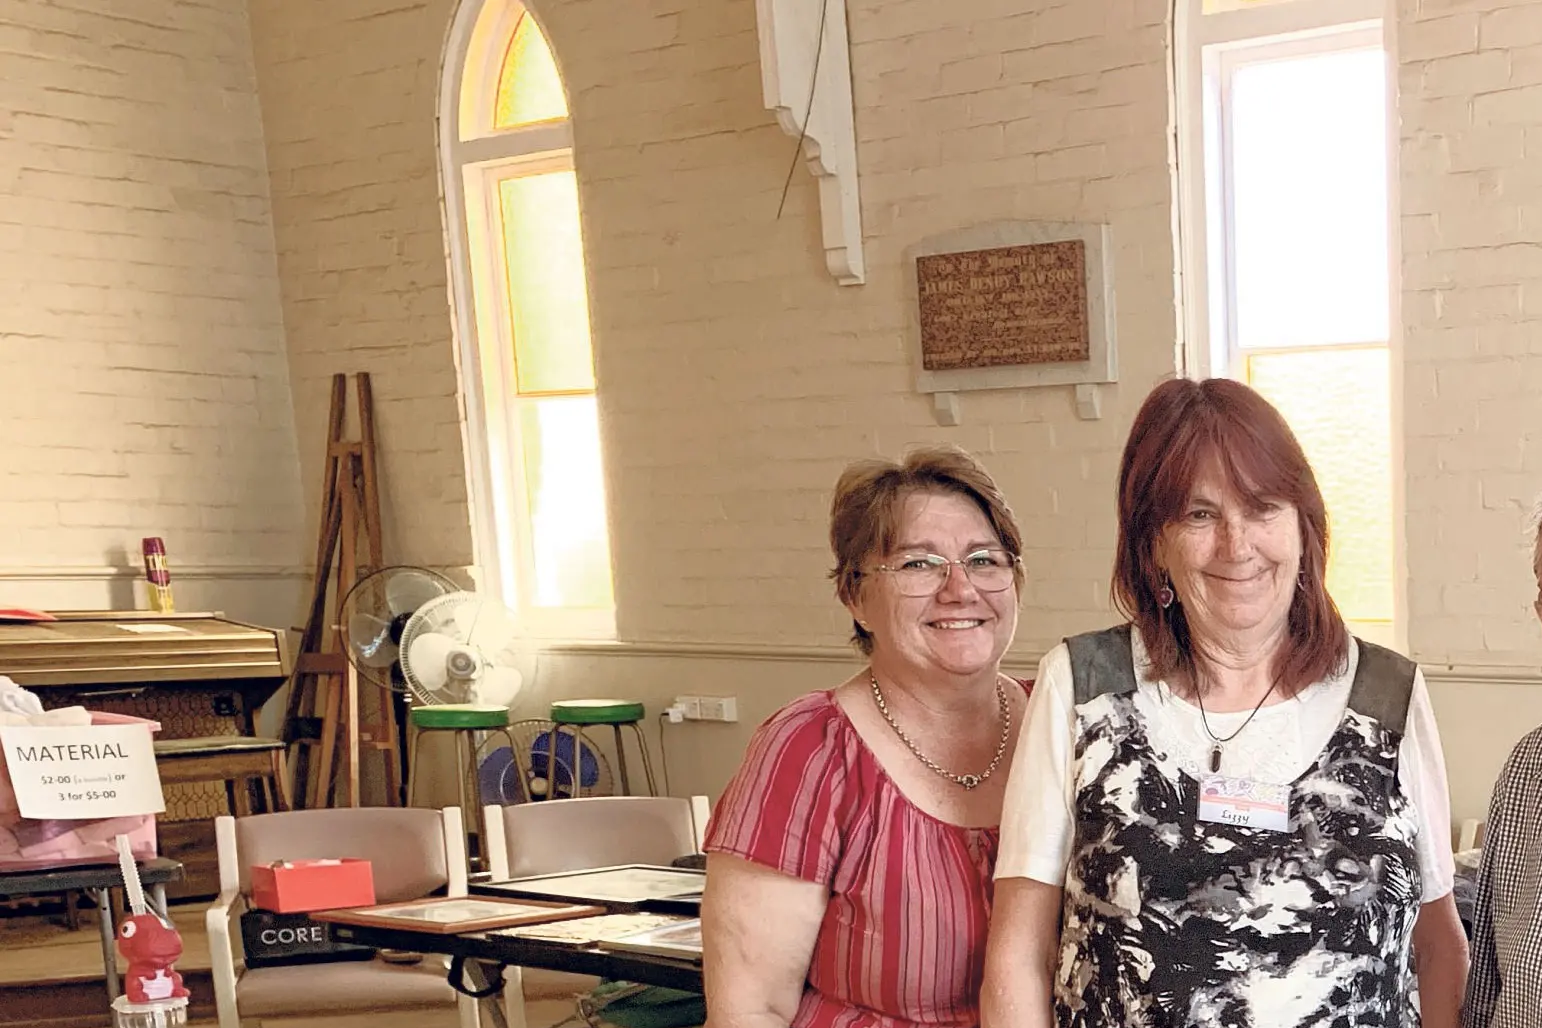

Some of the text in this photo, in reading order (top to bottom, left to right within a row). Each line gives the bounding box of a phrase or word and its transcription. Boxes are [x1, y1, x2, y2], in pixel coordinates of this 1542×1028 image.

[16, 743, 129, 762] MATERIAL
[40, 775, 71, 785] $2-00
[114, 774, 126, 782] or
[58, 790, 117, 802] 3 for $5-00
[261, 926, 322, 945] CORE
